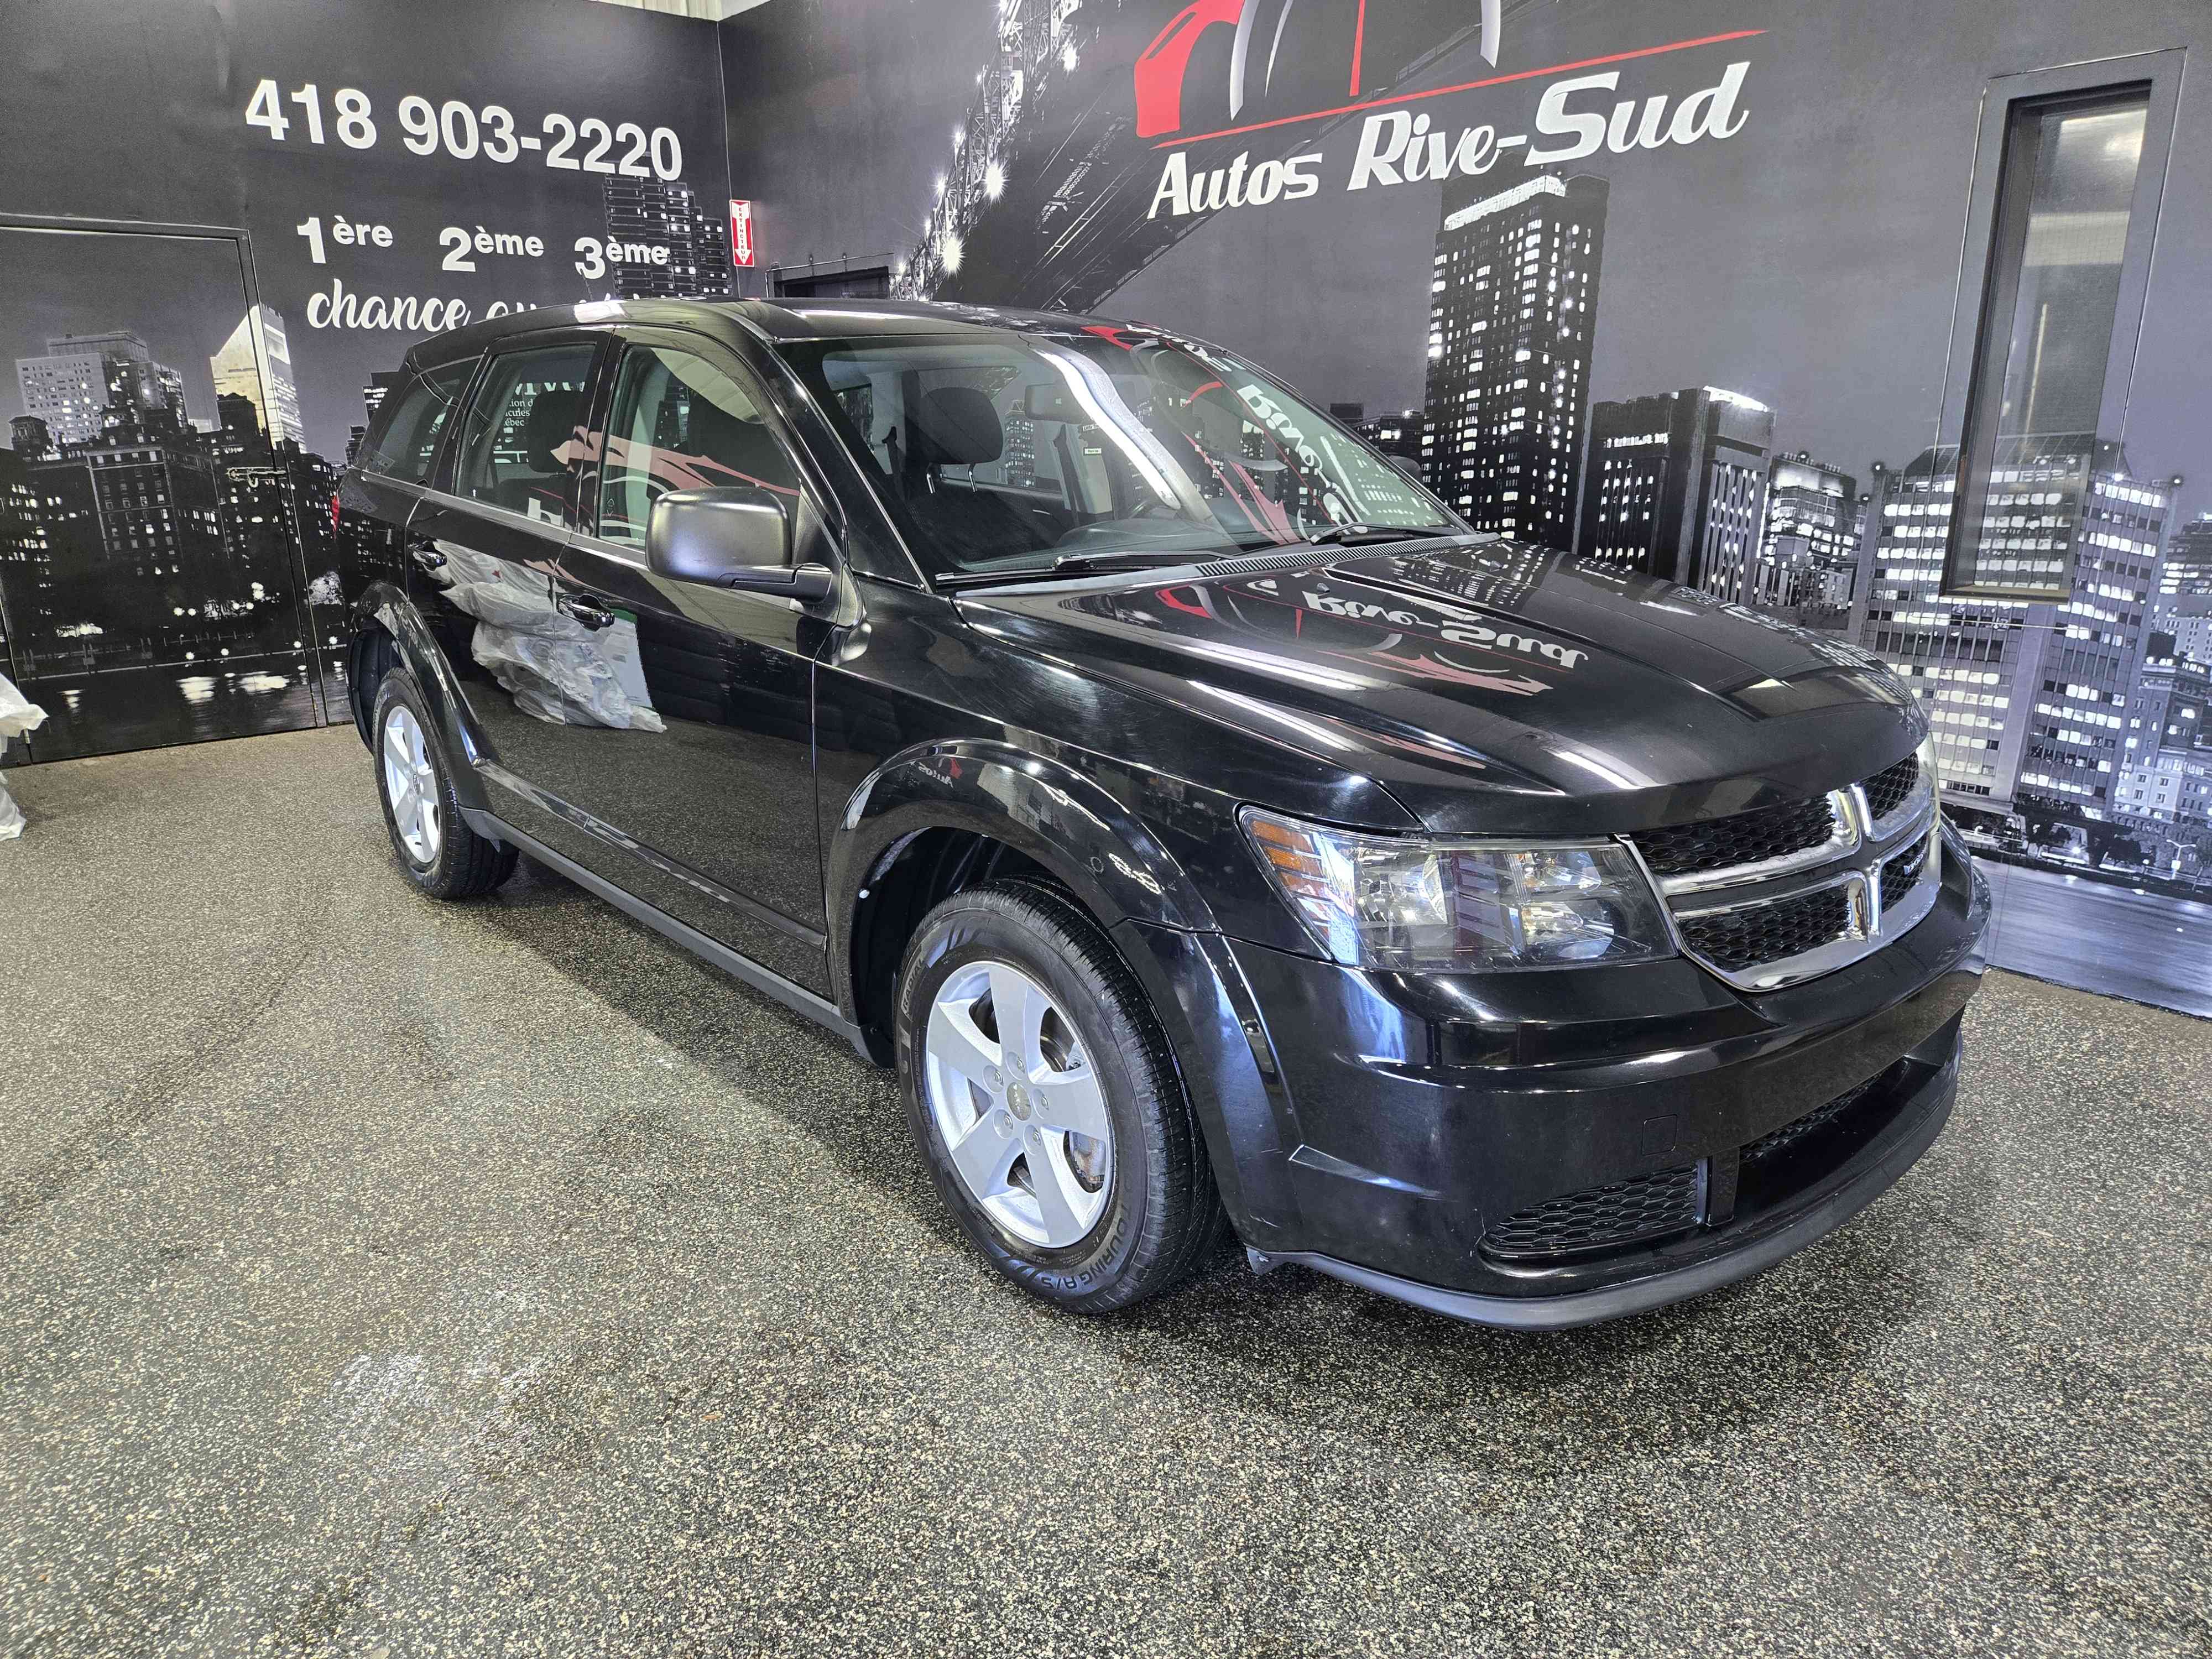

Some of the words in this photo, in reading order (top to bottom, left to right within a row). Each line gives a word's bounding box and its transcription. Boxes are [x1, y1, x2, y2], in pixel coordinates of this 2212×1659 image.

[244, 79, 377, 149] 418
[398, 95, 683, 181] 903-2220
[1146, 150, 1324, 220] Autos
[1345, 61, 1751, 192] Rive-Sud
[296, 215, 393, 264] 1ère
[439, 225, 545, 272] 2ème
[574, 236, 671, 279] 3ème
[738, 207, 746, 260] EXTINCTEUR
[307, 278, 471, 332] chance
